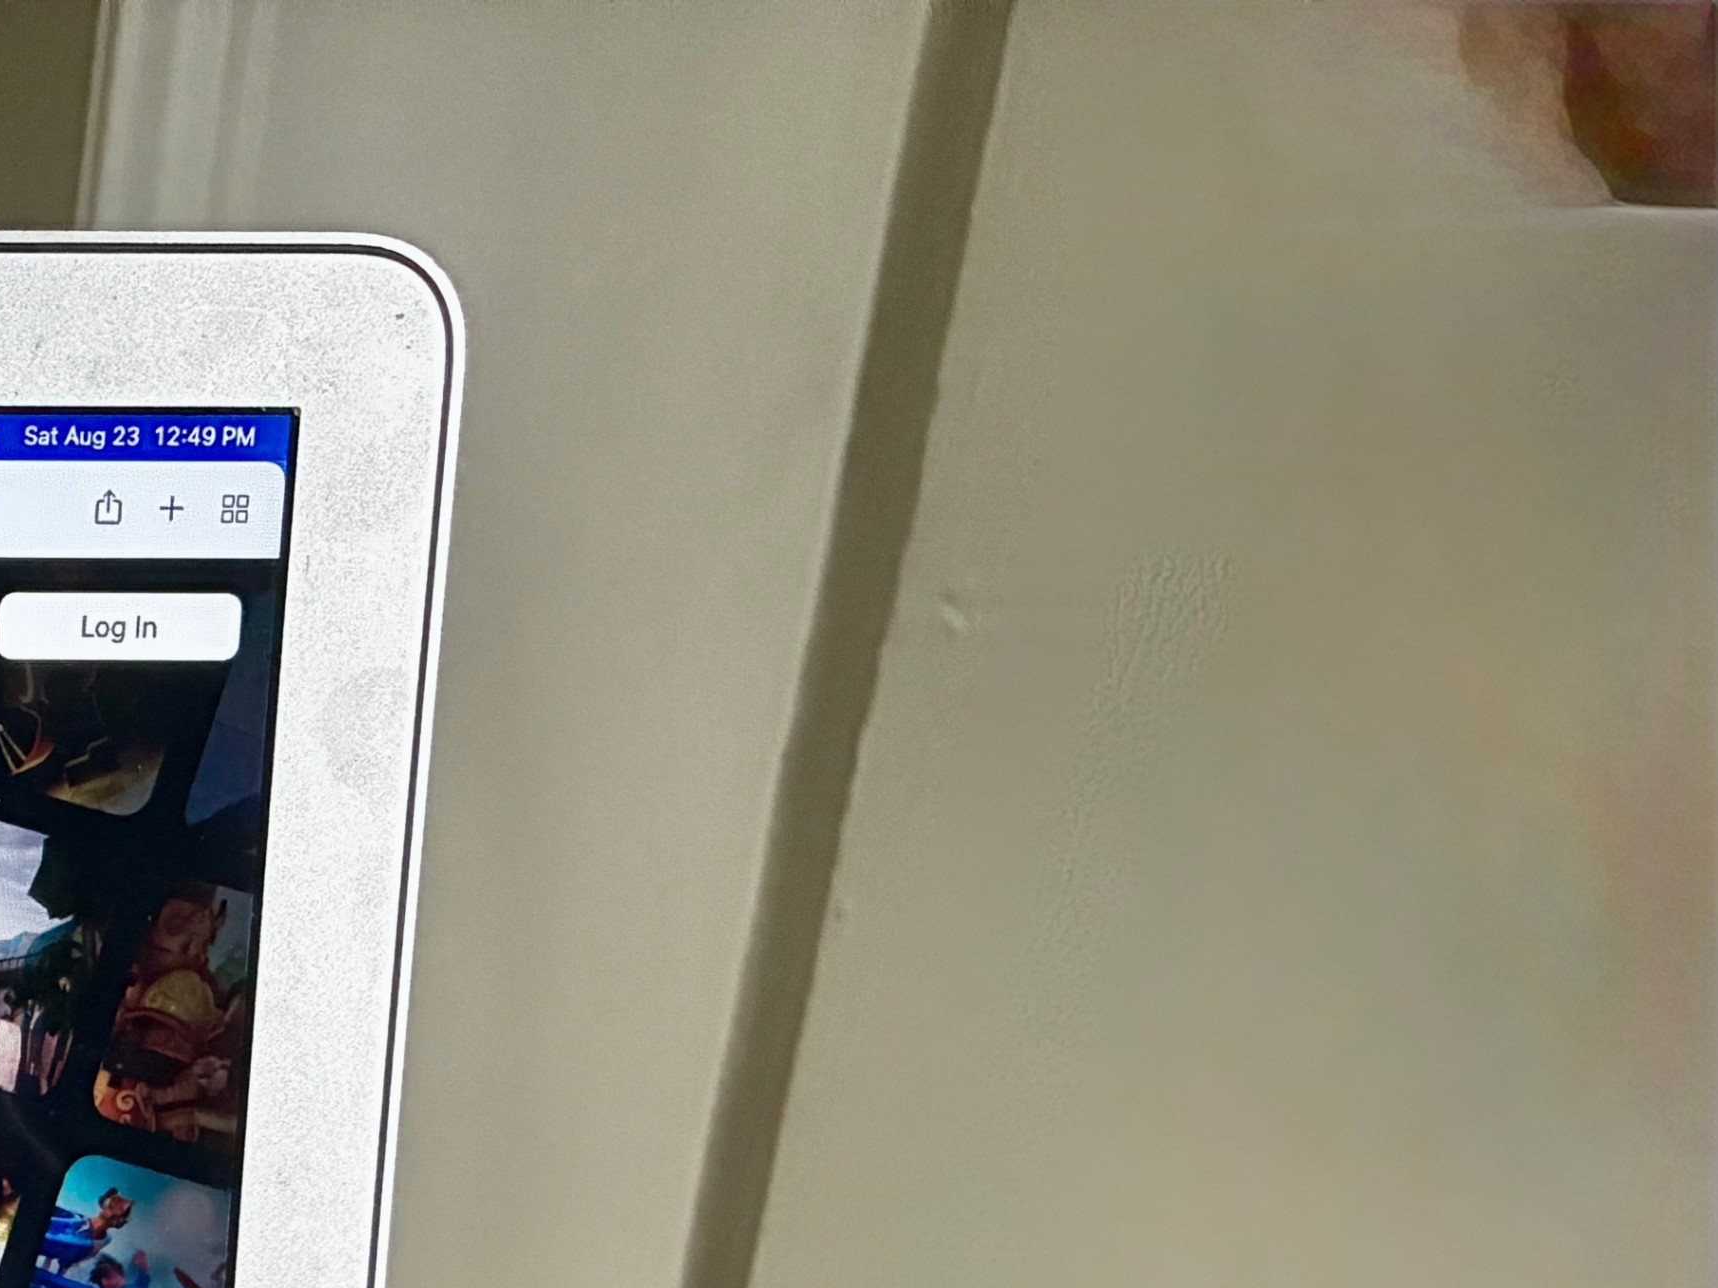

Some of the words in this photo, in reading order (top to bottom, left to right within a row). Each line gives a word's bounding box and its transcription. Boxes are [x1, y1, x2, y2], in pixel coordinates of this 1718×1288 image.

[24, 425, 59, 446] Sat
[63, 425, 106, 450] Aug
[112, 425, 140, 447] 23
[155, 425, 217, 447] 12:49
[221, 425, 256, 447] PM
[81, 614, 126, 644] Log
[135, 615, 158, 639] In
